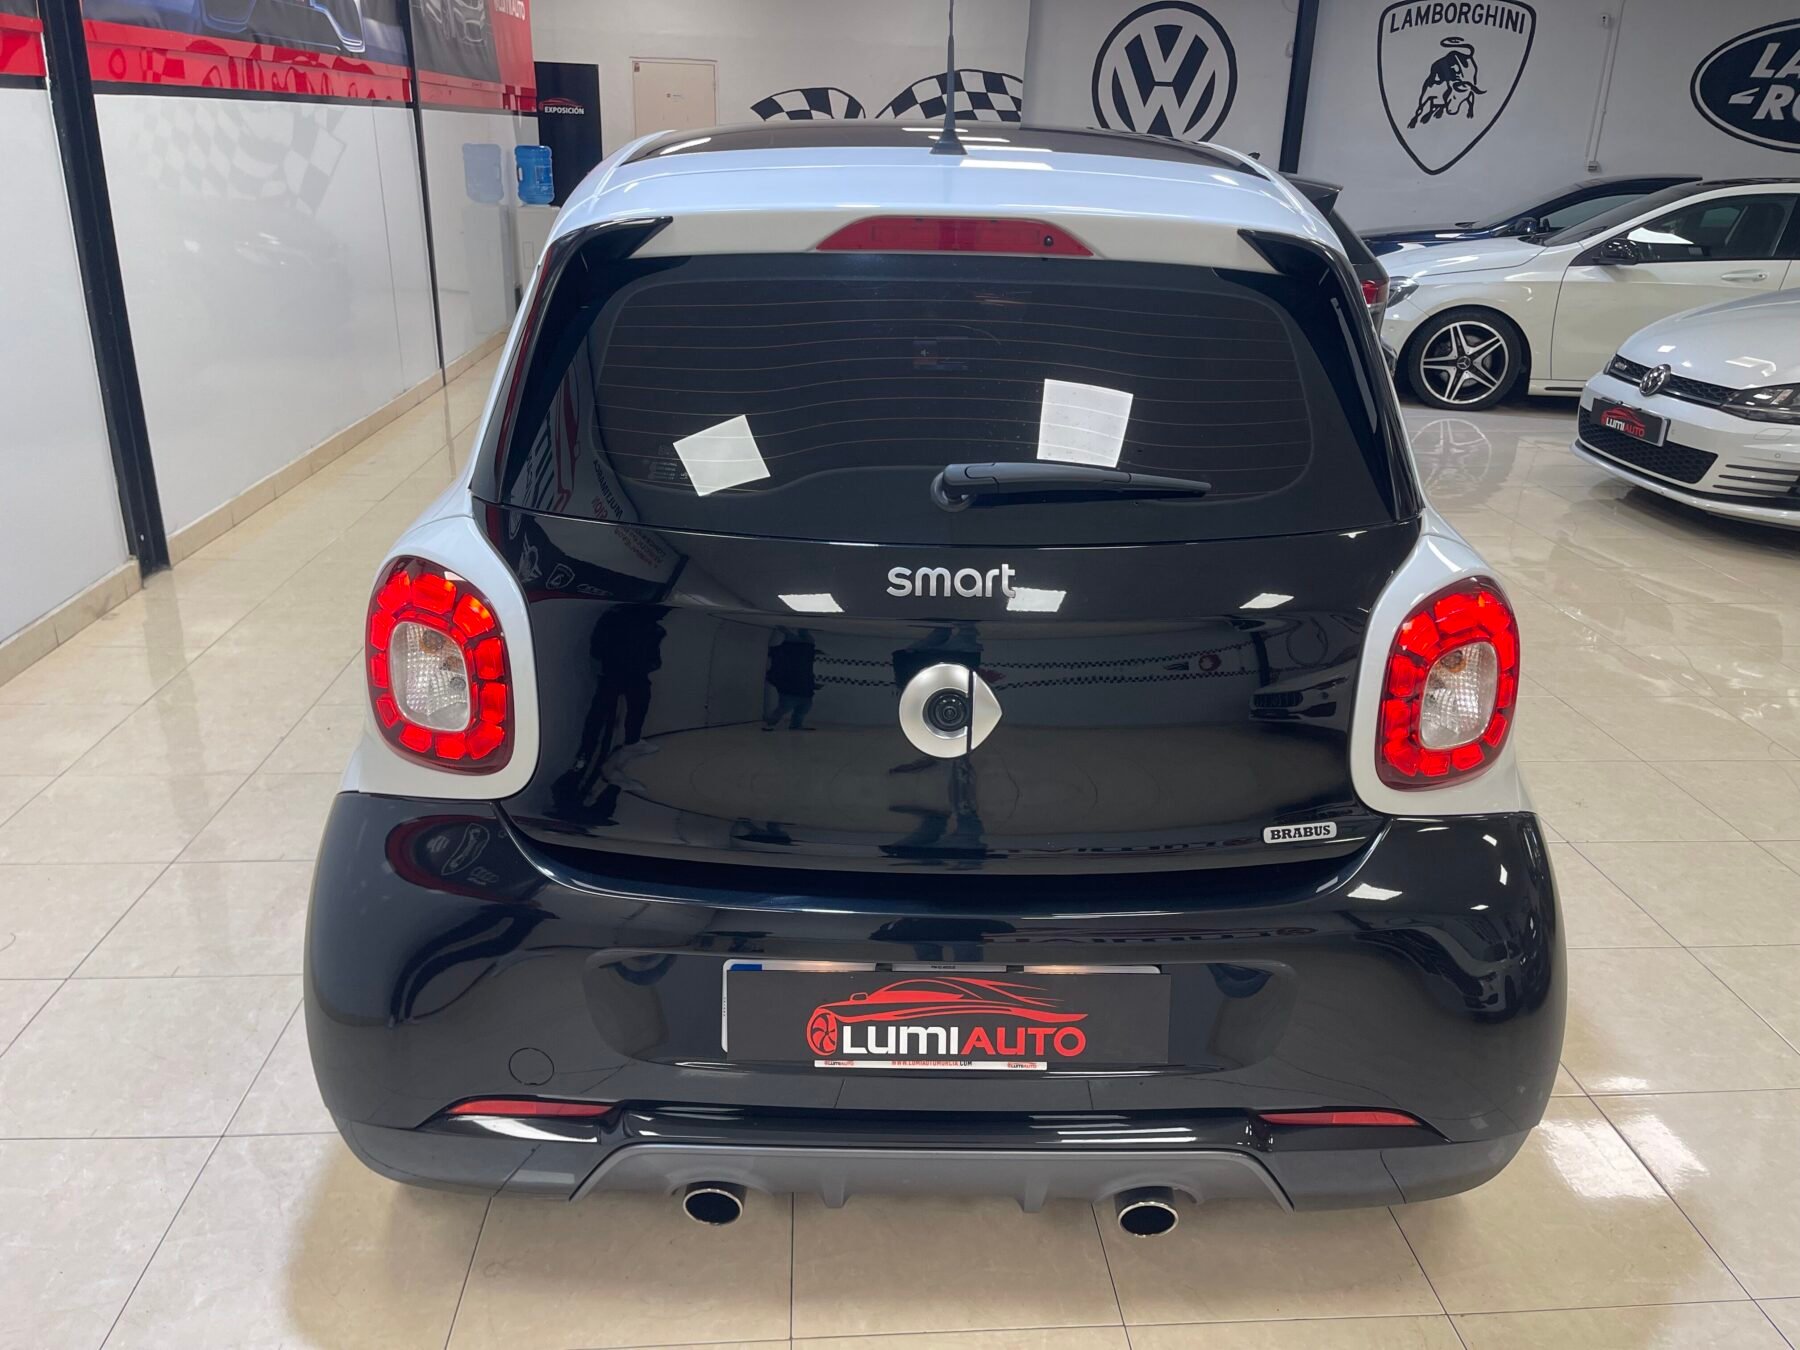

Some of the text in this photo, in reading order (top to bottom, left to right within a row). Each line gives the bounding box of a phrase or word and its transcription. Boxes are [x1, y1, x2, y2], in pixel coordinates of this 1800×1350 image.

[1390, 2, 1526, 34] LAMBORGHINI
[544, 105, 585, 115] EXPOSICIÓN
[1605, 417, 1645, 437] LUMIAUTO
[886, 563, 1017, 598] smart
[1270, 825, 1331, 841] BRABUS
[842, 1025, 1087, 1057] LUMIAUTO
